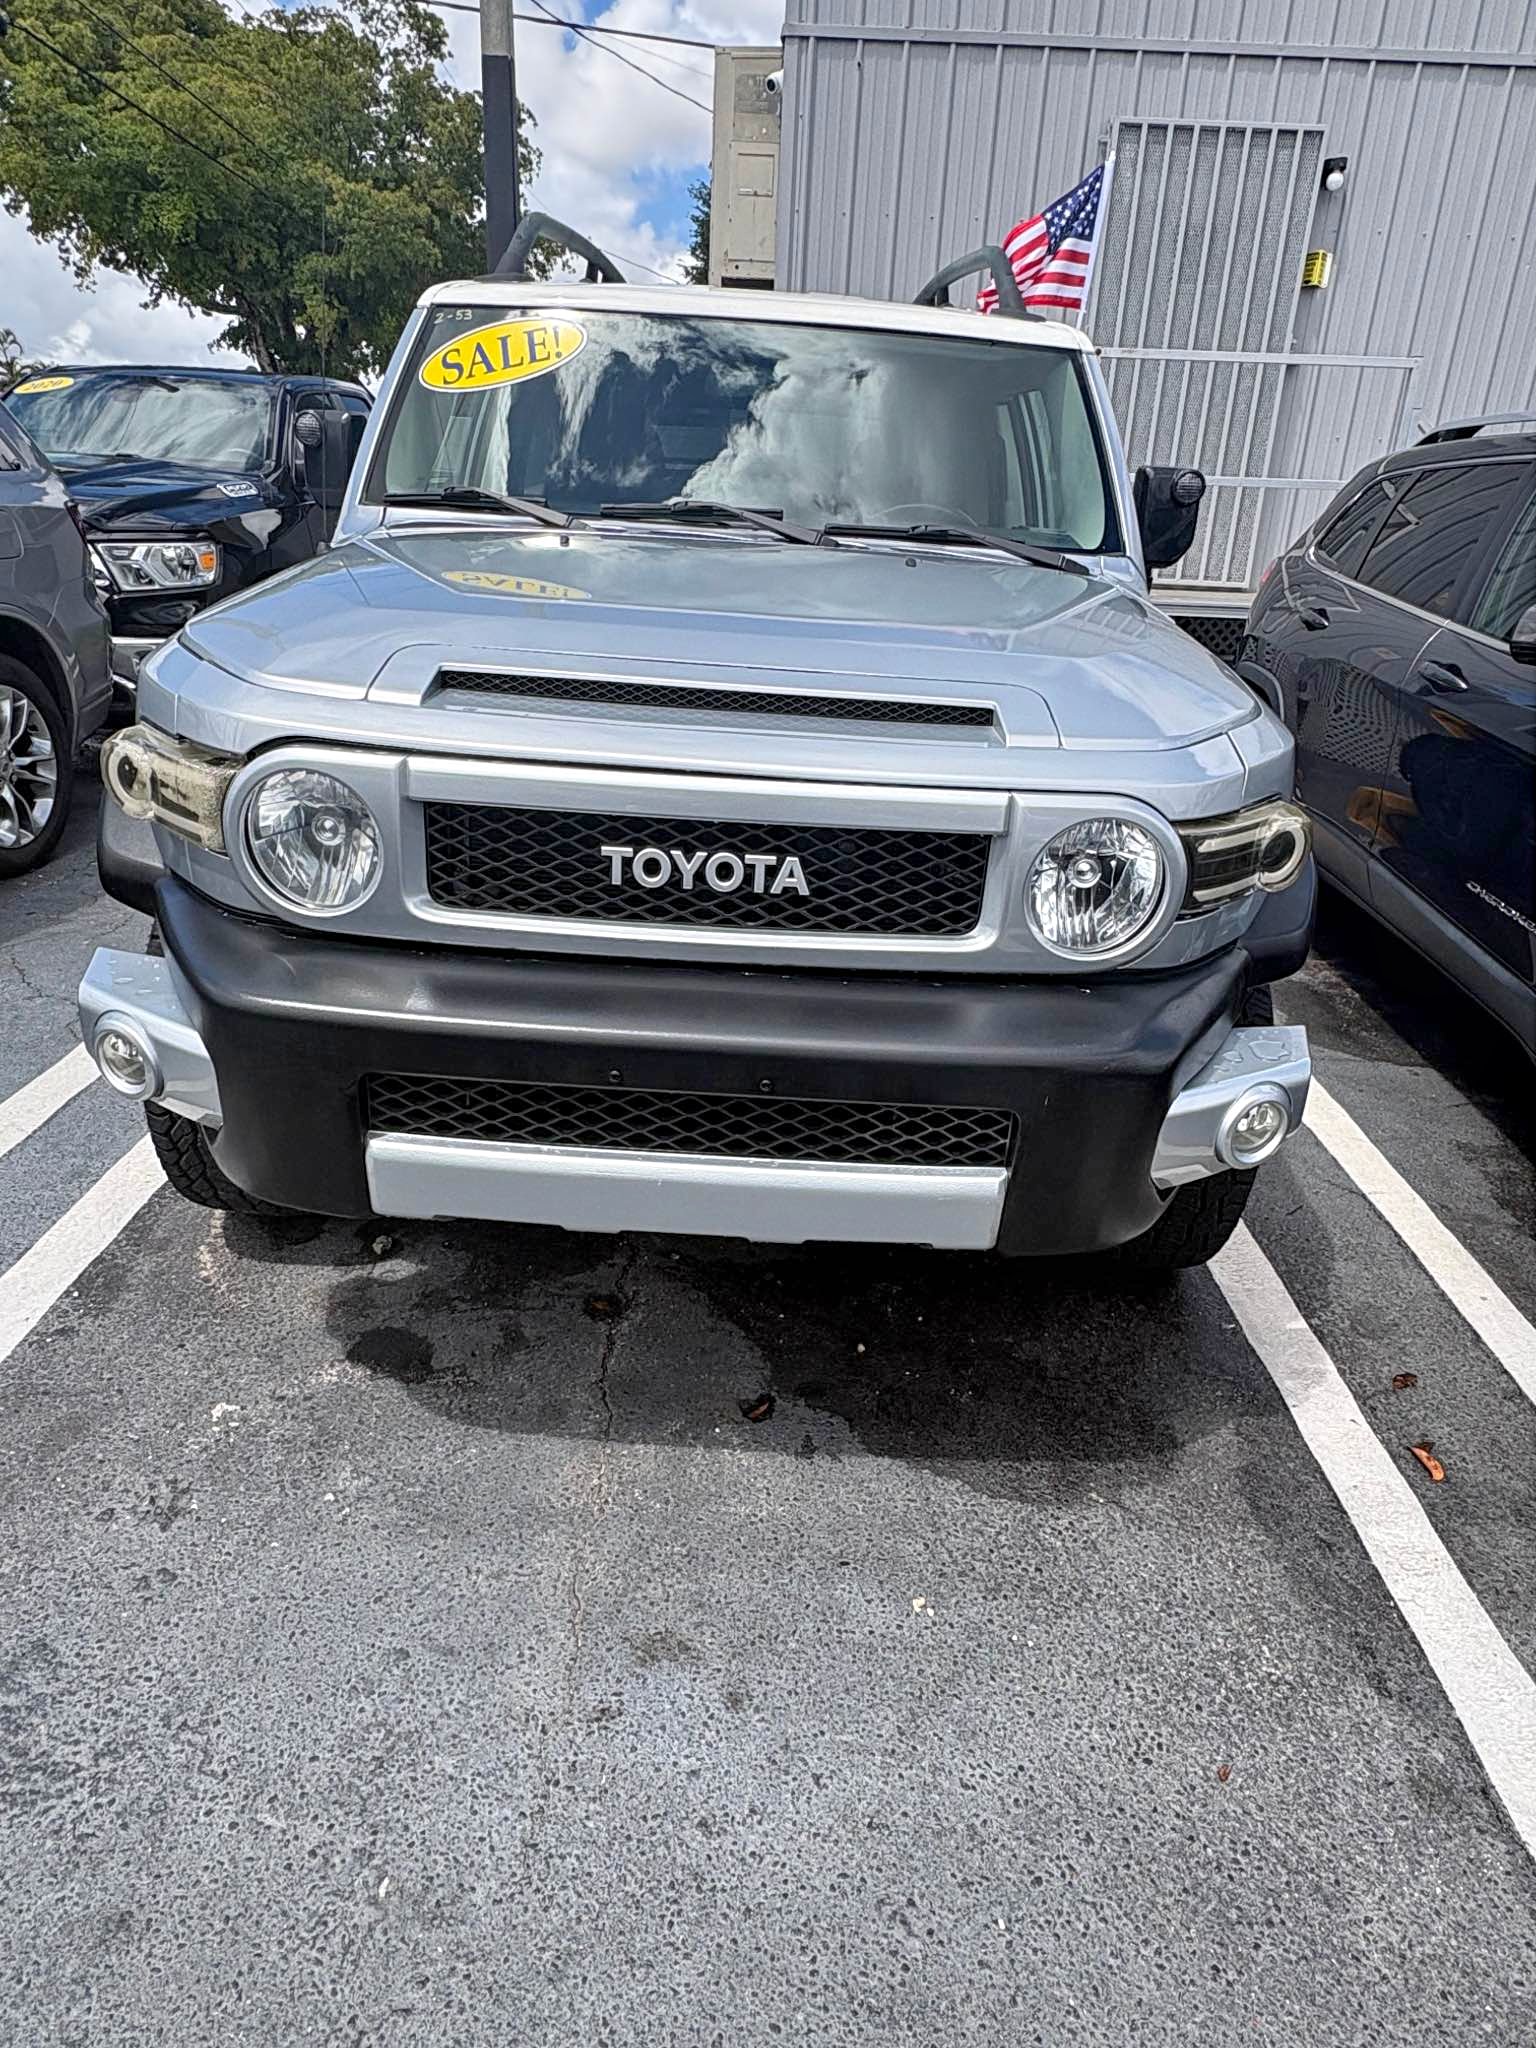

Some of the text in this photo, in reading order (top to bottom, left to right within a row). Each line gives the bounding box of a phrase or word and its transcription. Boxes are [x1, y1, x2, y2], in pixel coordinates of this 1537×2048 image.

[434, 309, 473, 324] 2-53
[441, 325, 563, 385] SALE!
[601, 846, 810, 896] TOYOTA
